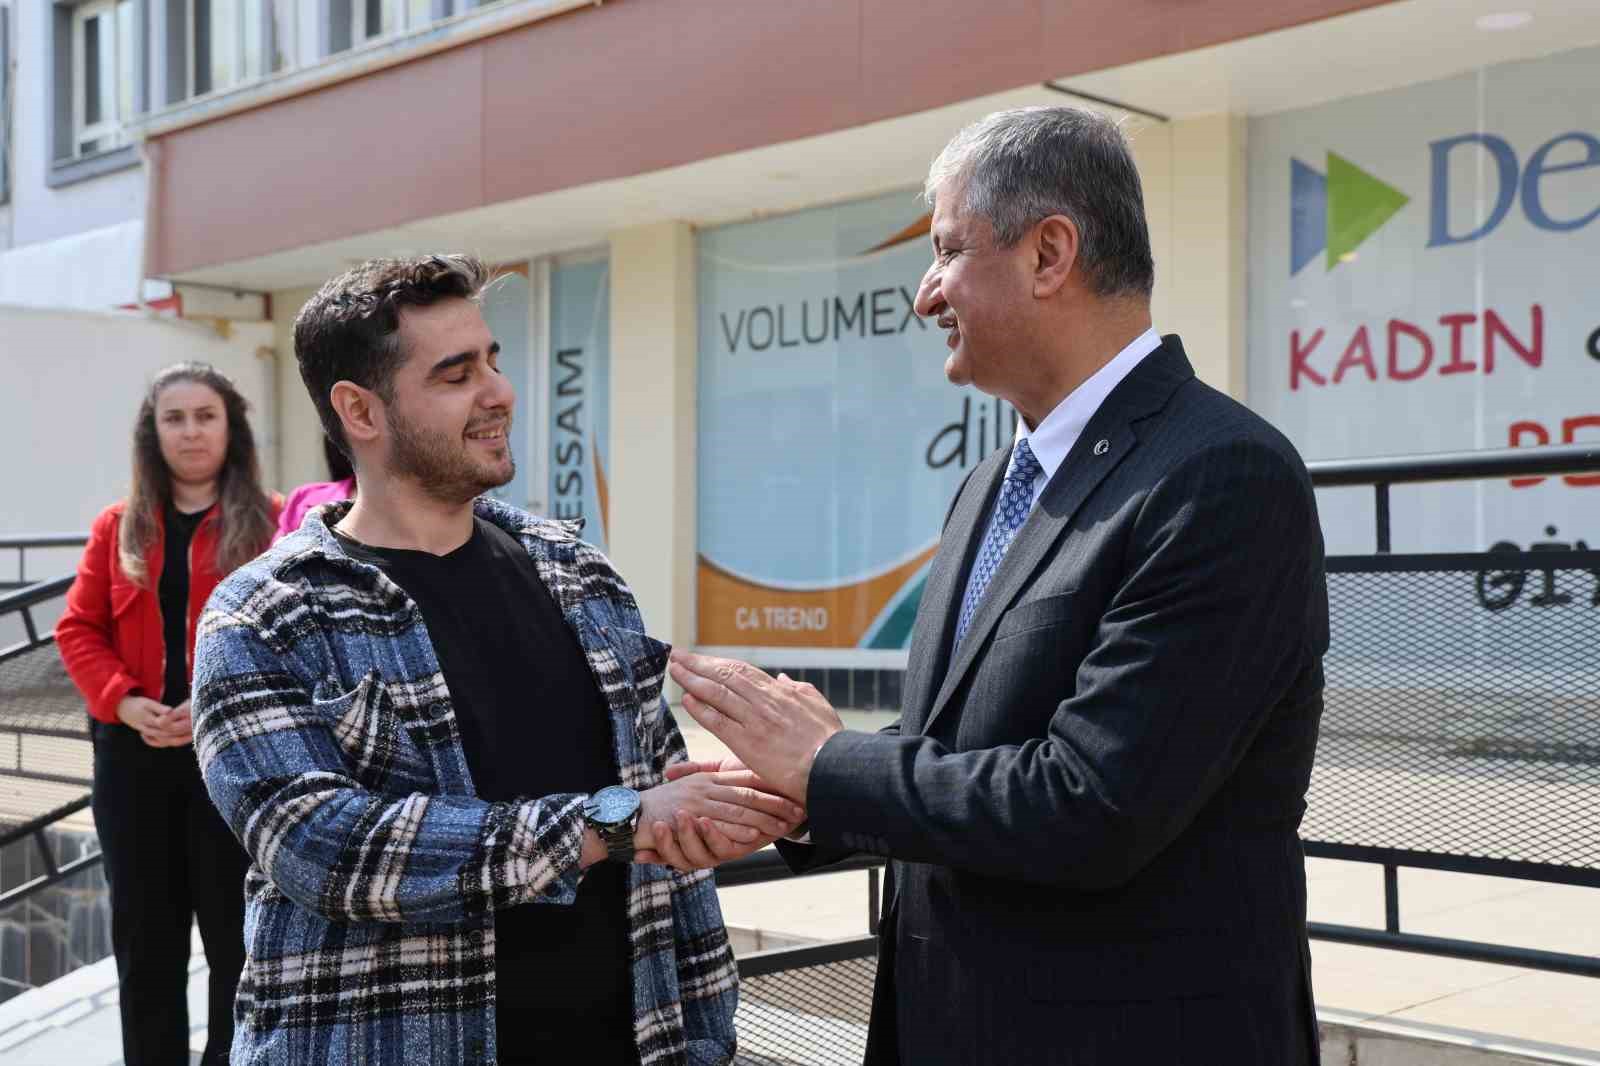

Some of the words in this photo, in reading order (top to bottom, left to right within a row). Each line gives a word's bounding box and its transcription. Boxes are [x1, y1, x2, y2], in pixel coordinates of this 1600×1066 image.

[720, 286, 926, 354] VOLUMEX
[1290, 303, 1544, 392] KADIN
[555, 347, 584, 538] ESSAM
[762, 607, 829, 631] TREND
